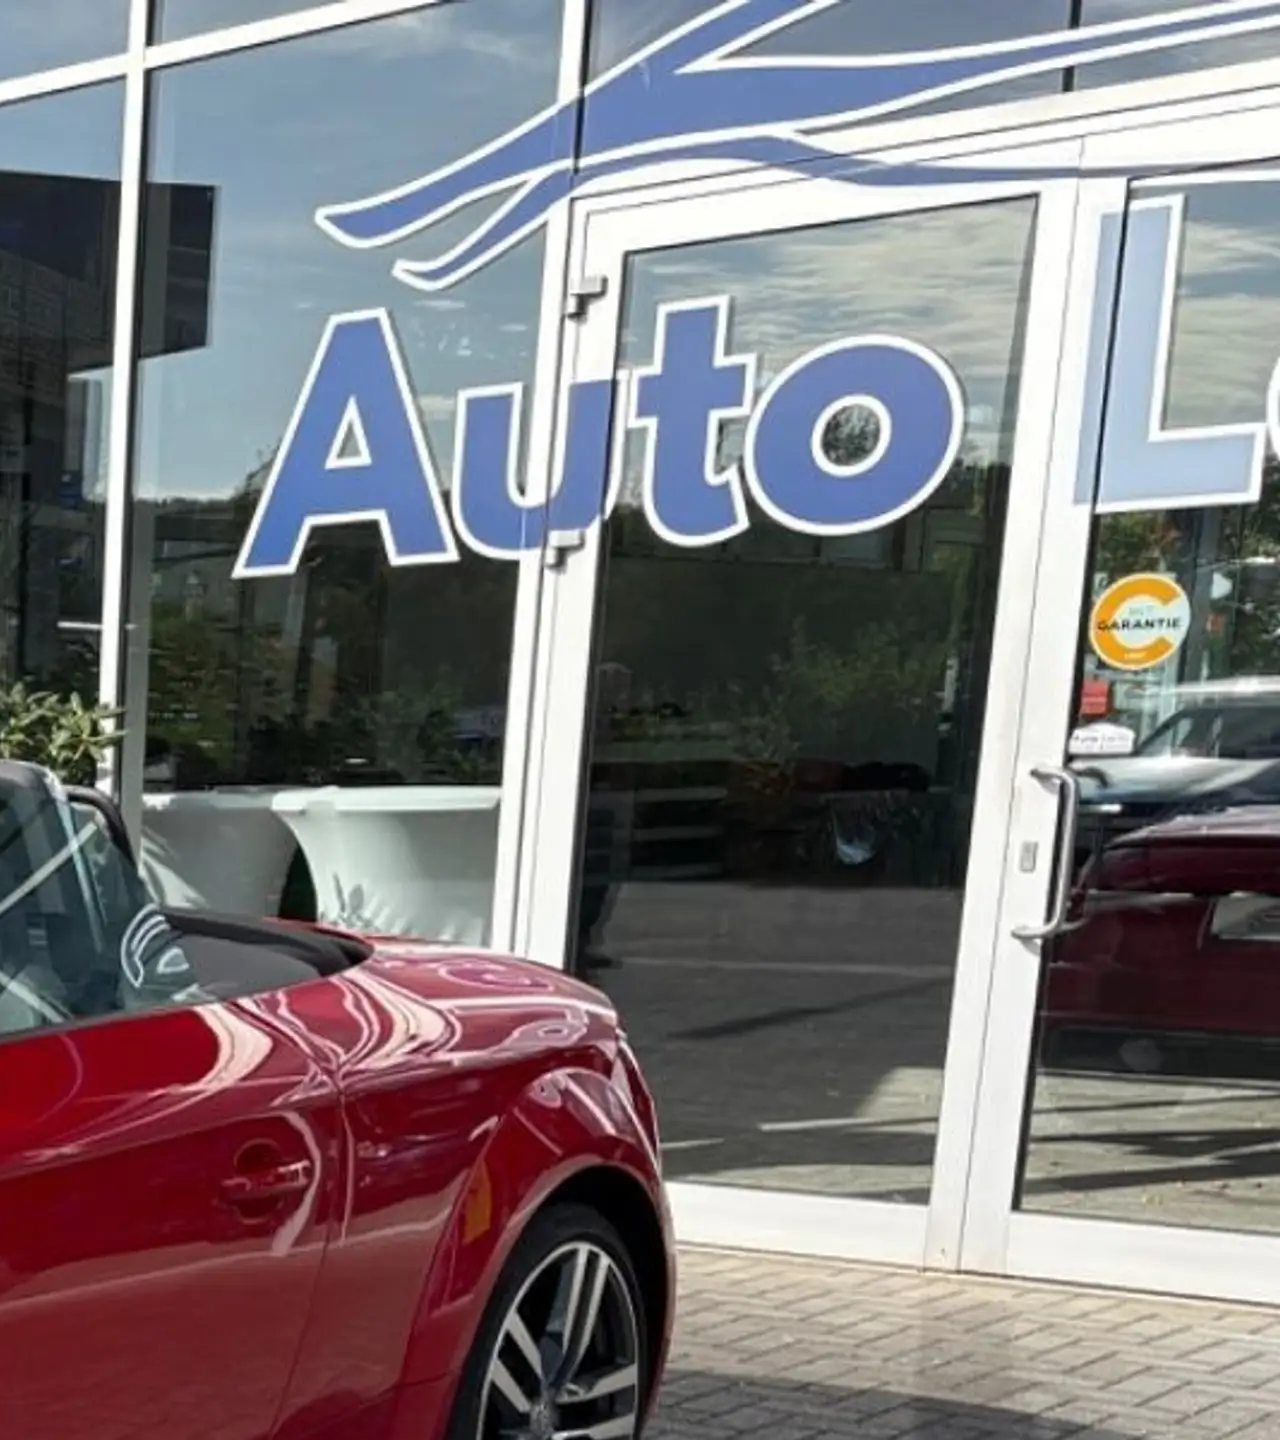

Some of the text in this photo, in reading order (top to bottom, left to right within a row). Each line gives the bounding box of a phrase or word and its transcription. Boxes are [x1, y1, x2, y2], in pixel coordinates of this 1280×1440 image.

[231, 192, 1279, 580] Auto L
[1097, 615, 1183, 633] GARANTIE
